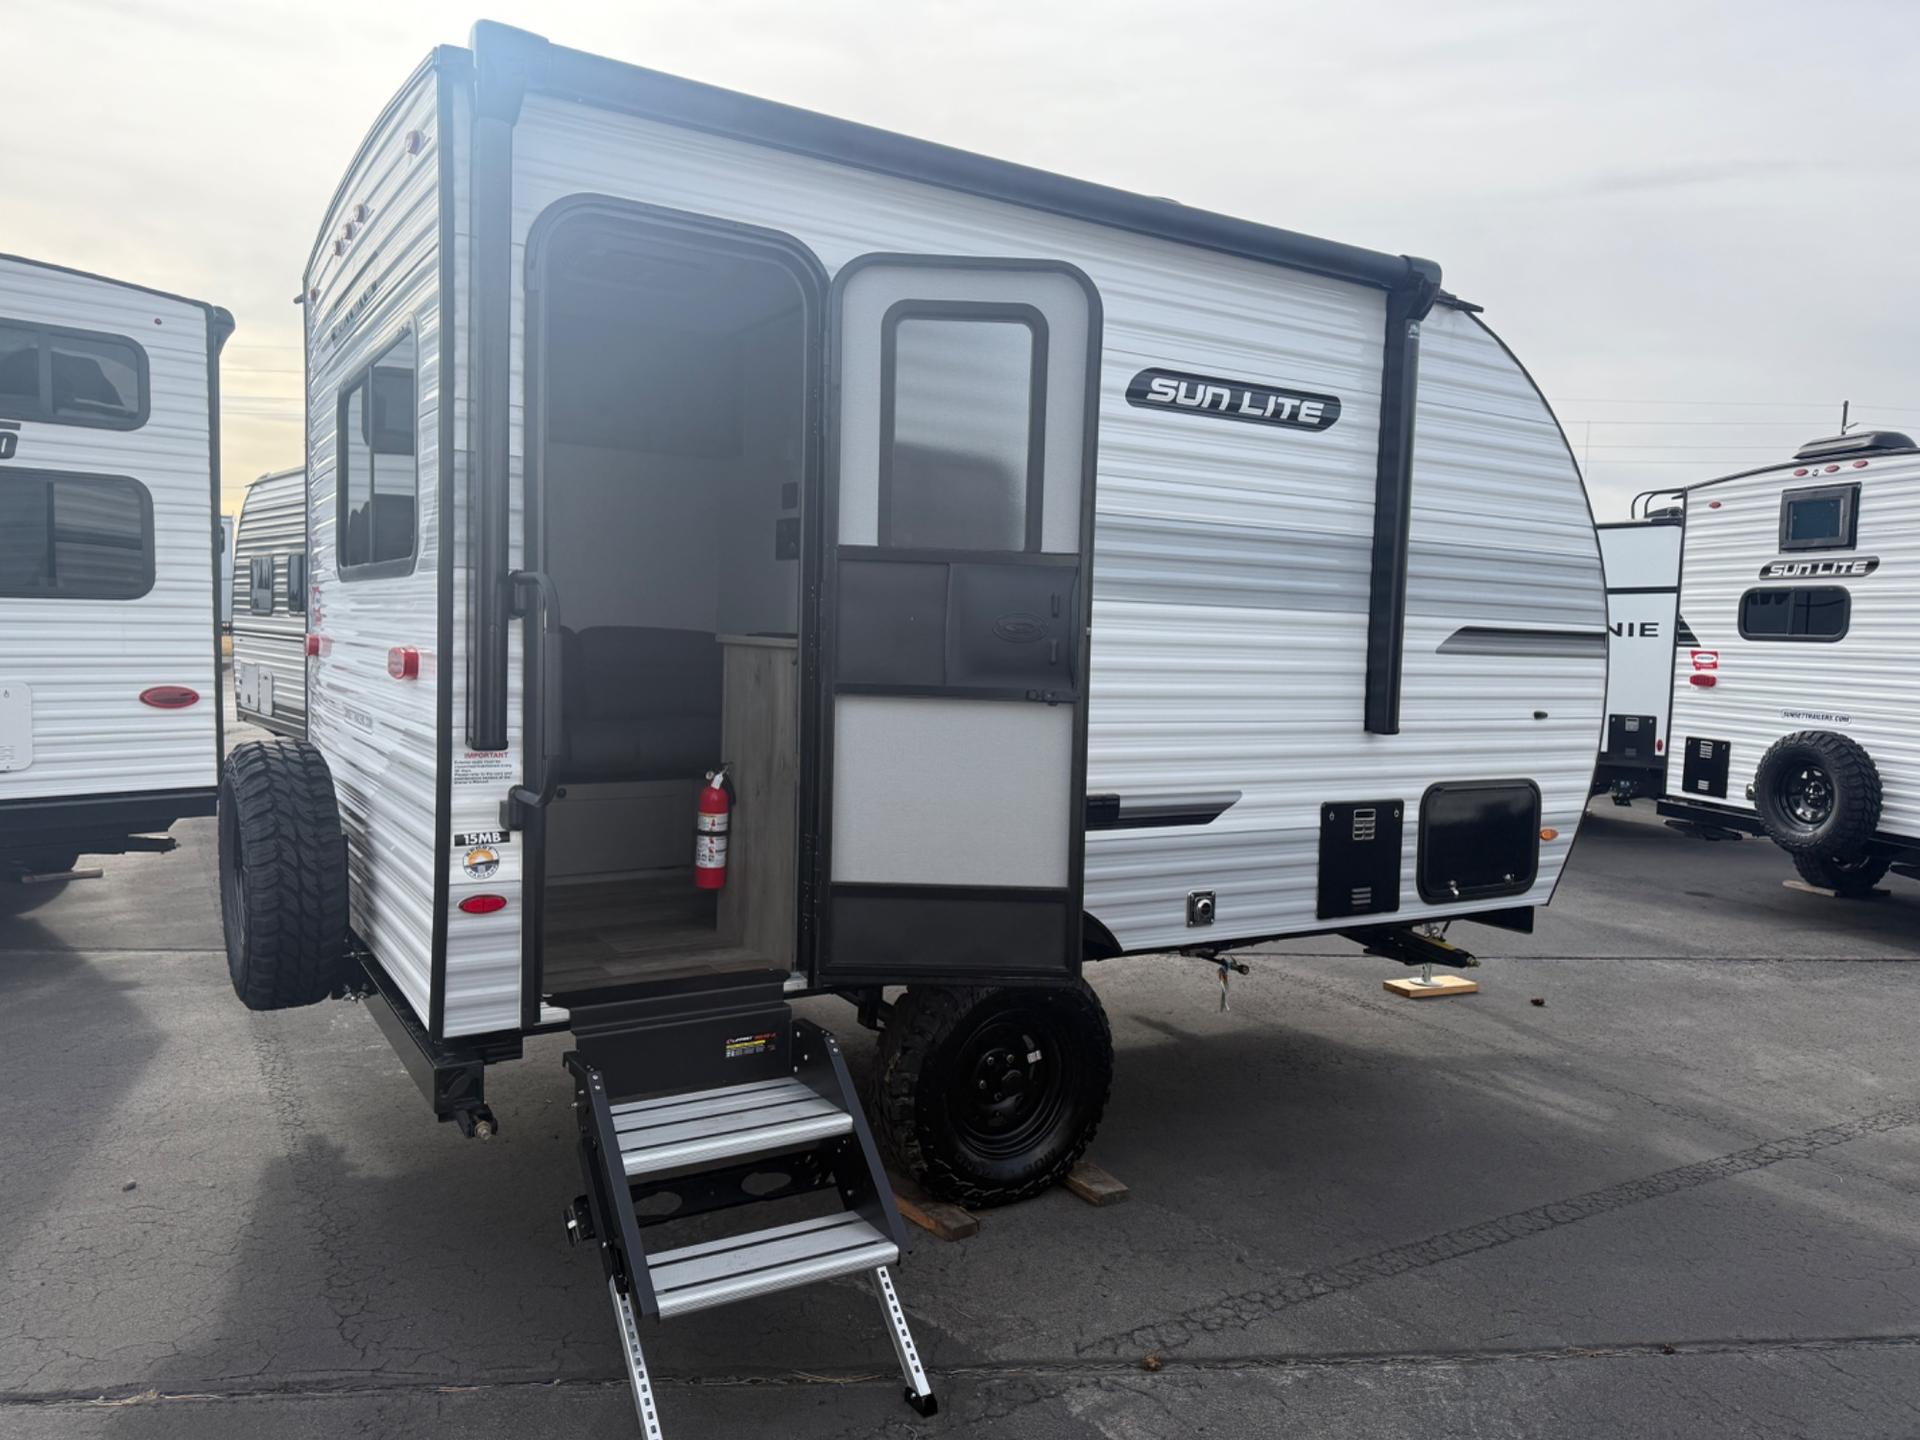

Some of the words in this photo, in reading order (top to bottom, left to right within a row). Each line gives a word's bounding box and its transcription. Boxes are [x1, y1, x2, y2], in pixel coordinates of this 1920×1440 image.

[1146, 377, 1231, 412] SUN
[1238, 390, 1325, 425] LITE
[1768, 563, 1812, 577] SUN
[1816, 561, 1868, 575] LITE
[464, 832, 501, 844] 15MB
